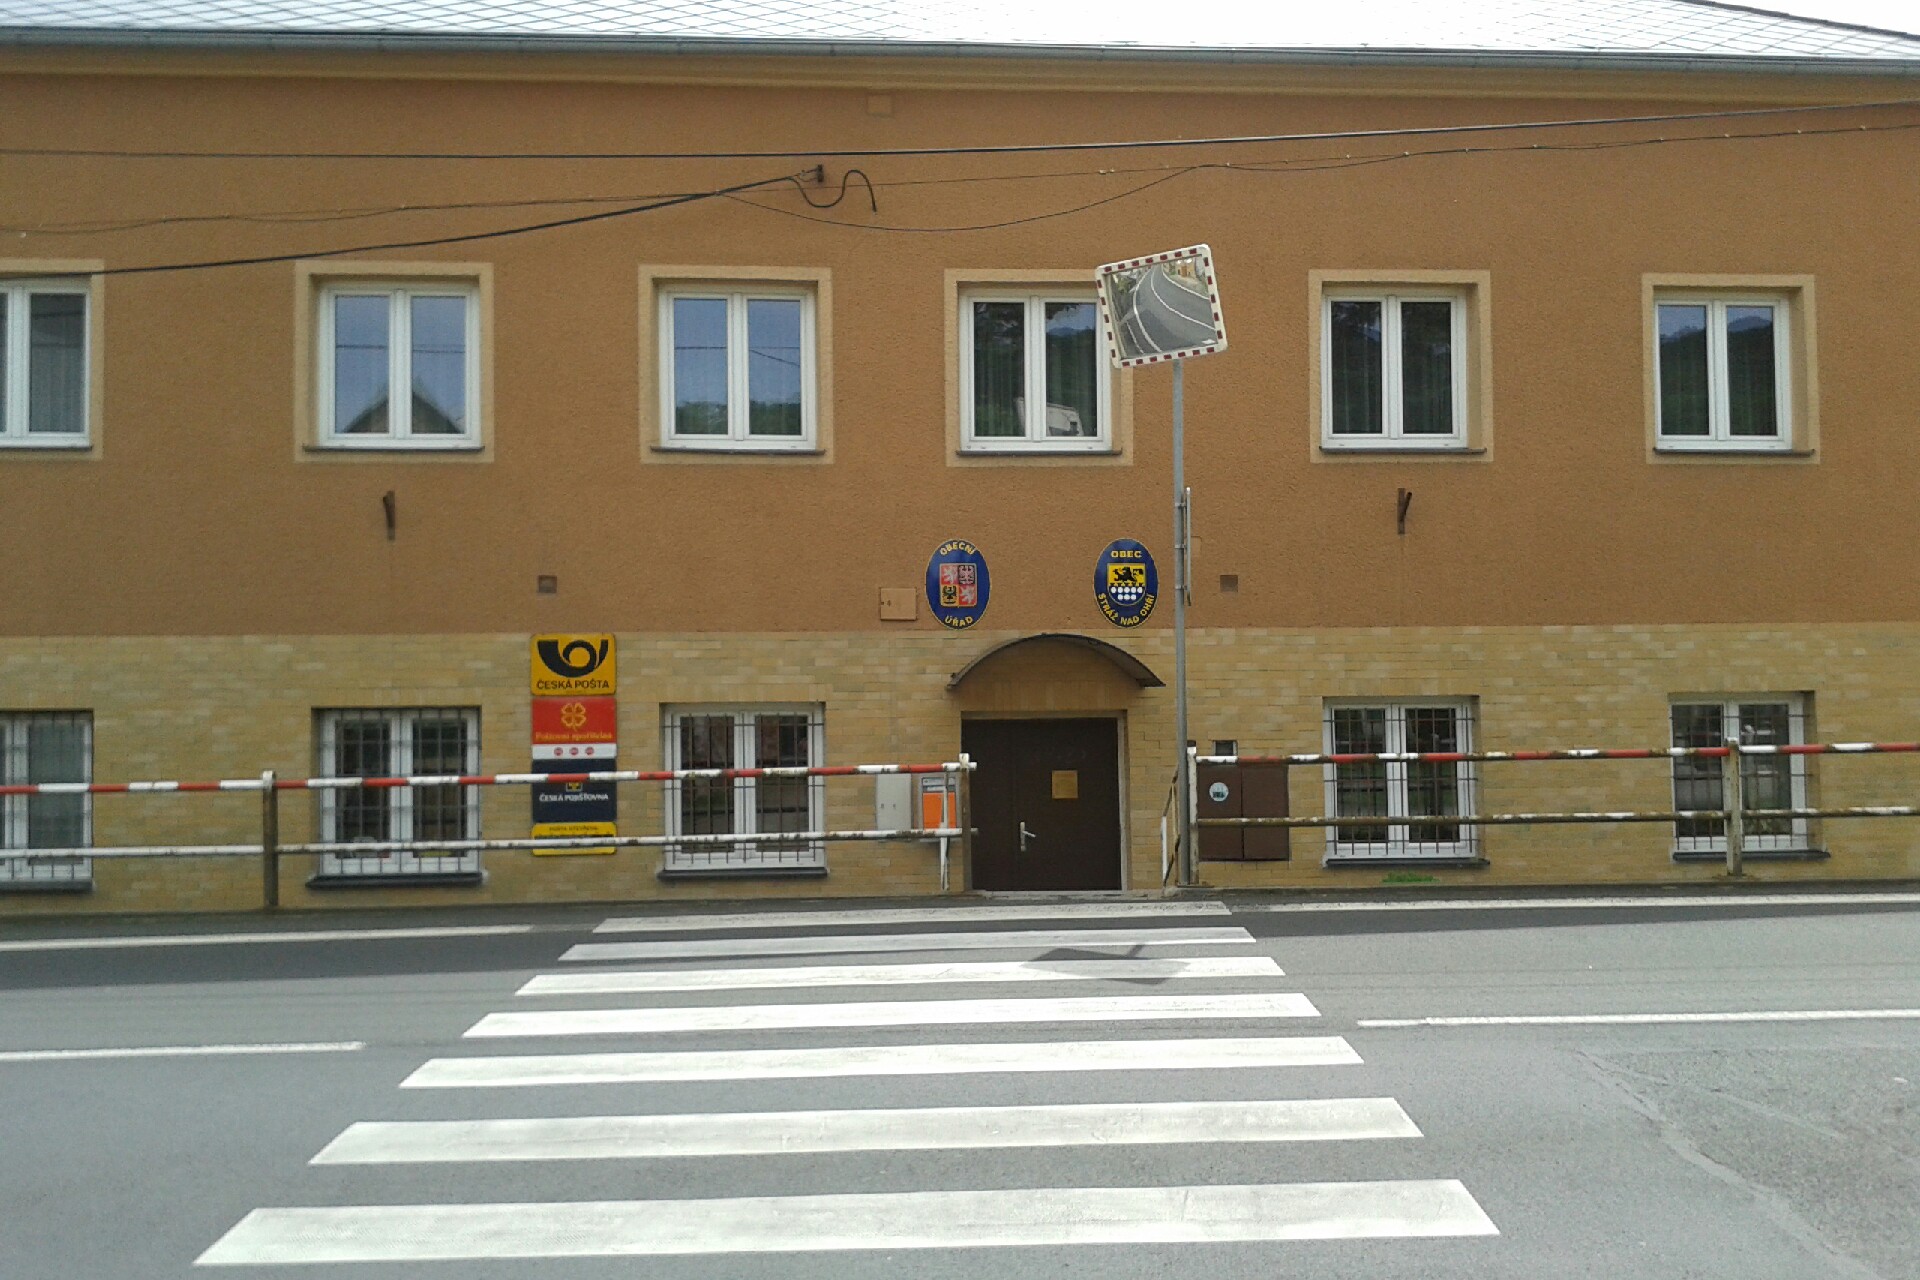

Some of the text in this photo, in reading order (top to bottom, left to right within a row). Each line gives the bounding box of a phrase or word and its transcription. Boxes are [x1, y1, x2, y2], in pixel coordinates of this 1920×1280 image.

[940, 542, 976, 555] OBECNÍ
[945, 615, 973, 626] ÚŘAD
[1121, 616, 1140, 625] NAD
[537, 679, 609, 689] ČESKÁ POŠTA
[539, 792, 563, 801] ČESKÁ
